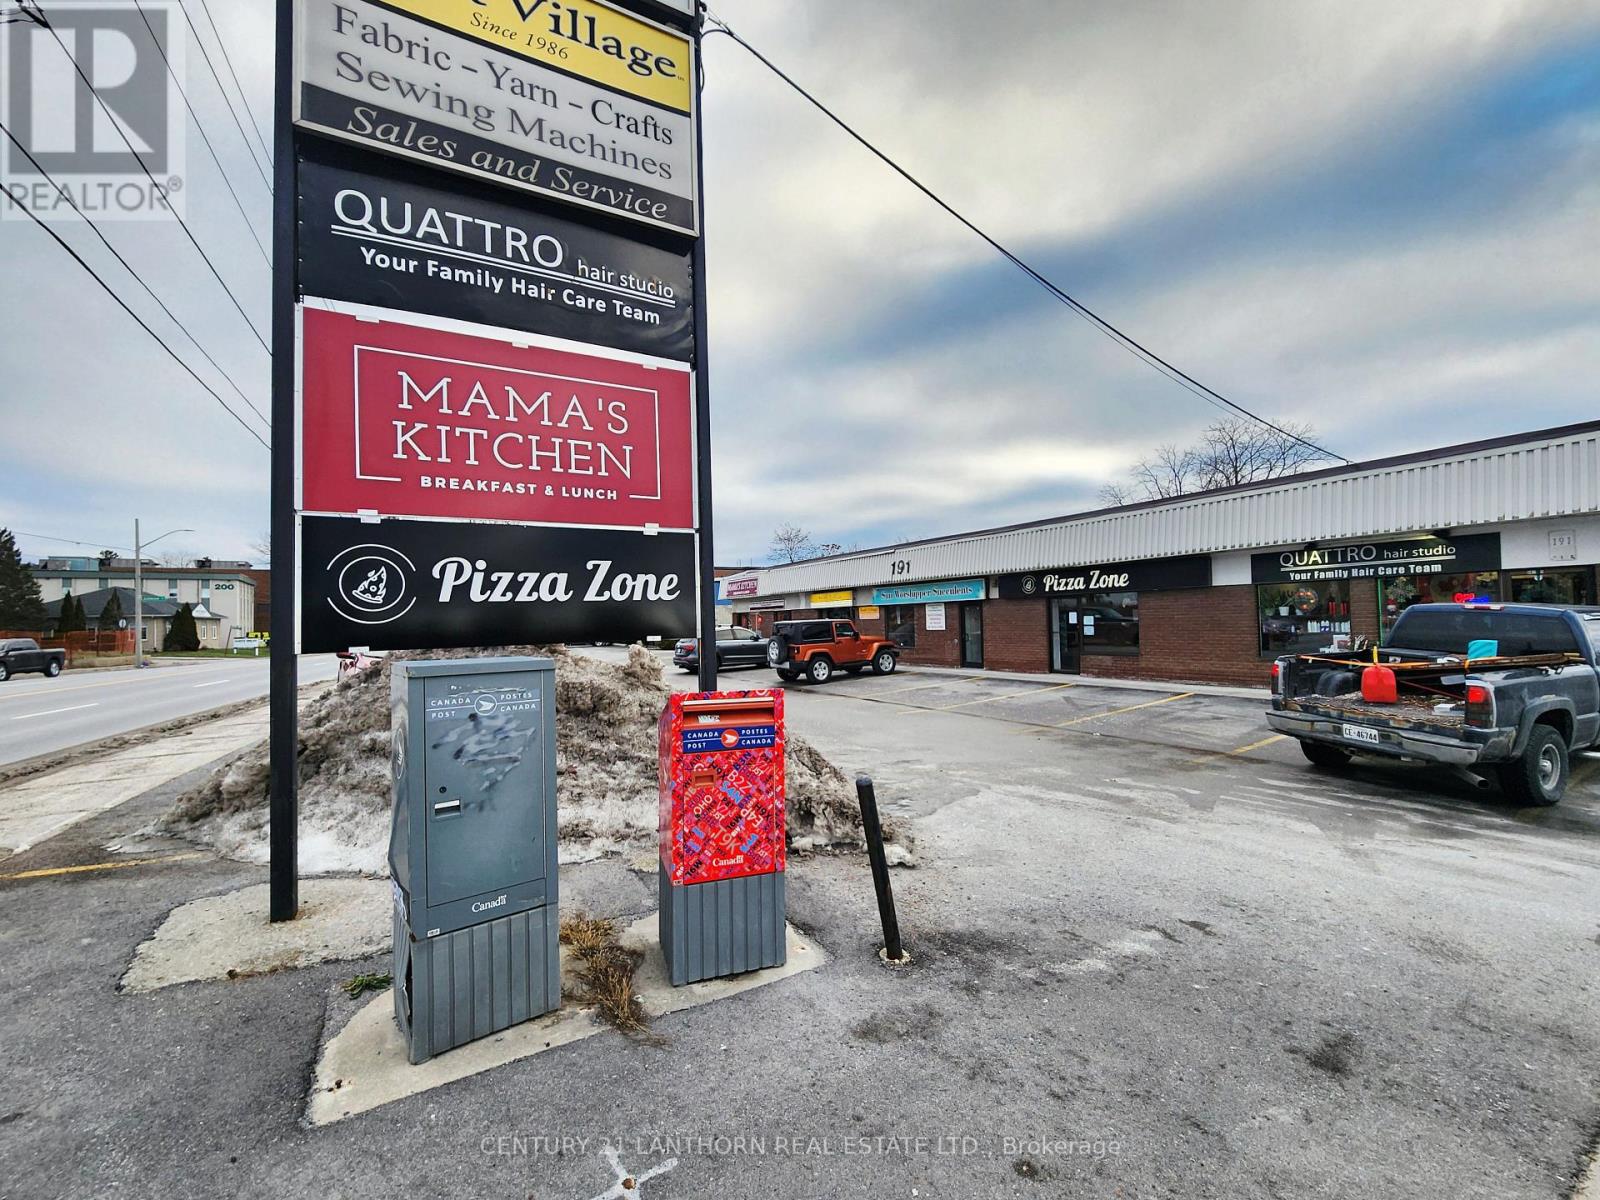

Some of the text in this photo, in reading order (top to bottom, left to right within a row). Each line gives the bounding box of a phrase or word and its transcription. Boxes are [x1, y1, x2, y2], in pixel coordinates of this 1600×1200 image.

[470, 11, 569, 60] Since 1986
[333, 3, 452, 72] Fabric
[483, 59, 559, 109] Yarn
[591, 98, 673, 146] Crafts
[335, 51, 673, 181] Sewing Machines
[346, 105, 669, 220] Sales and Service
[333, 188, 675, 299] QUATTRO hair studio
[360, 246, 661, 326] Your Family Hair Care Team
[397, 371, 630, 434] MAMA'S
[392, 420, 633, 480] KITCHEN
[420, 475, 618, 500] BREAKFAST & LUNCH
[891, 560, 911, 575] 191
[1279, 544, 1456, 567] QUATTRO hair studio
[432, 556, 681, 604] Pizza Zone
[1043, 570, 1130, 592] Pizza Zone
[1289, 563, 1442, 581] Your Family Hair Care Team
[933, 584, 973, 597] Succulents
[430, 692, 532, 707] CANADA POSTES
[431, 703, 536, 719] POST CANADA
[687, 731, 719, 739] CANADA
[471, 894, 507, 913] Canada
